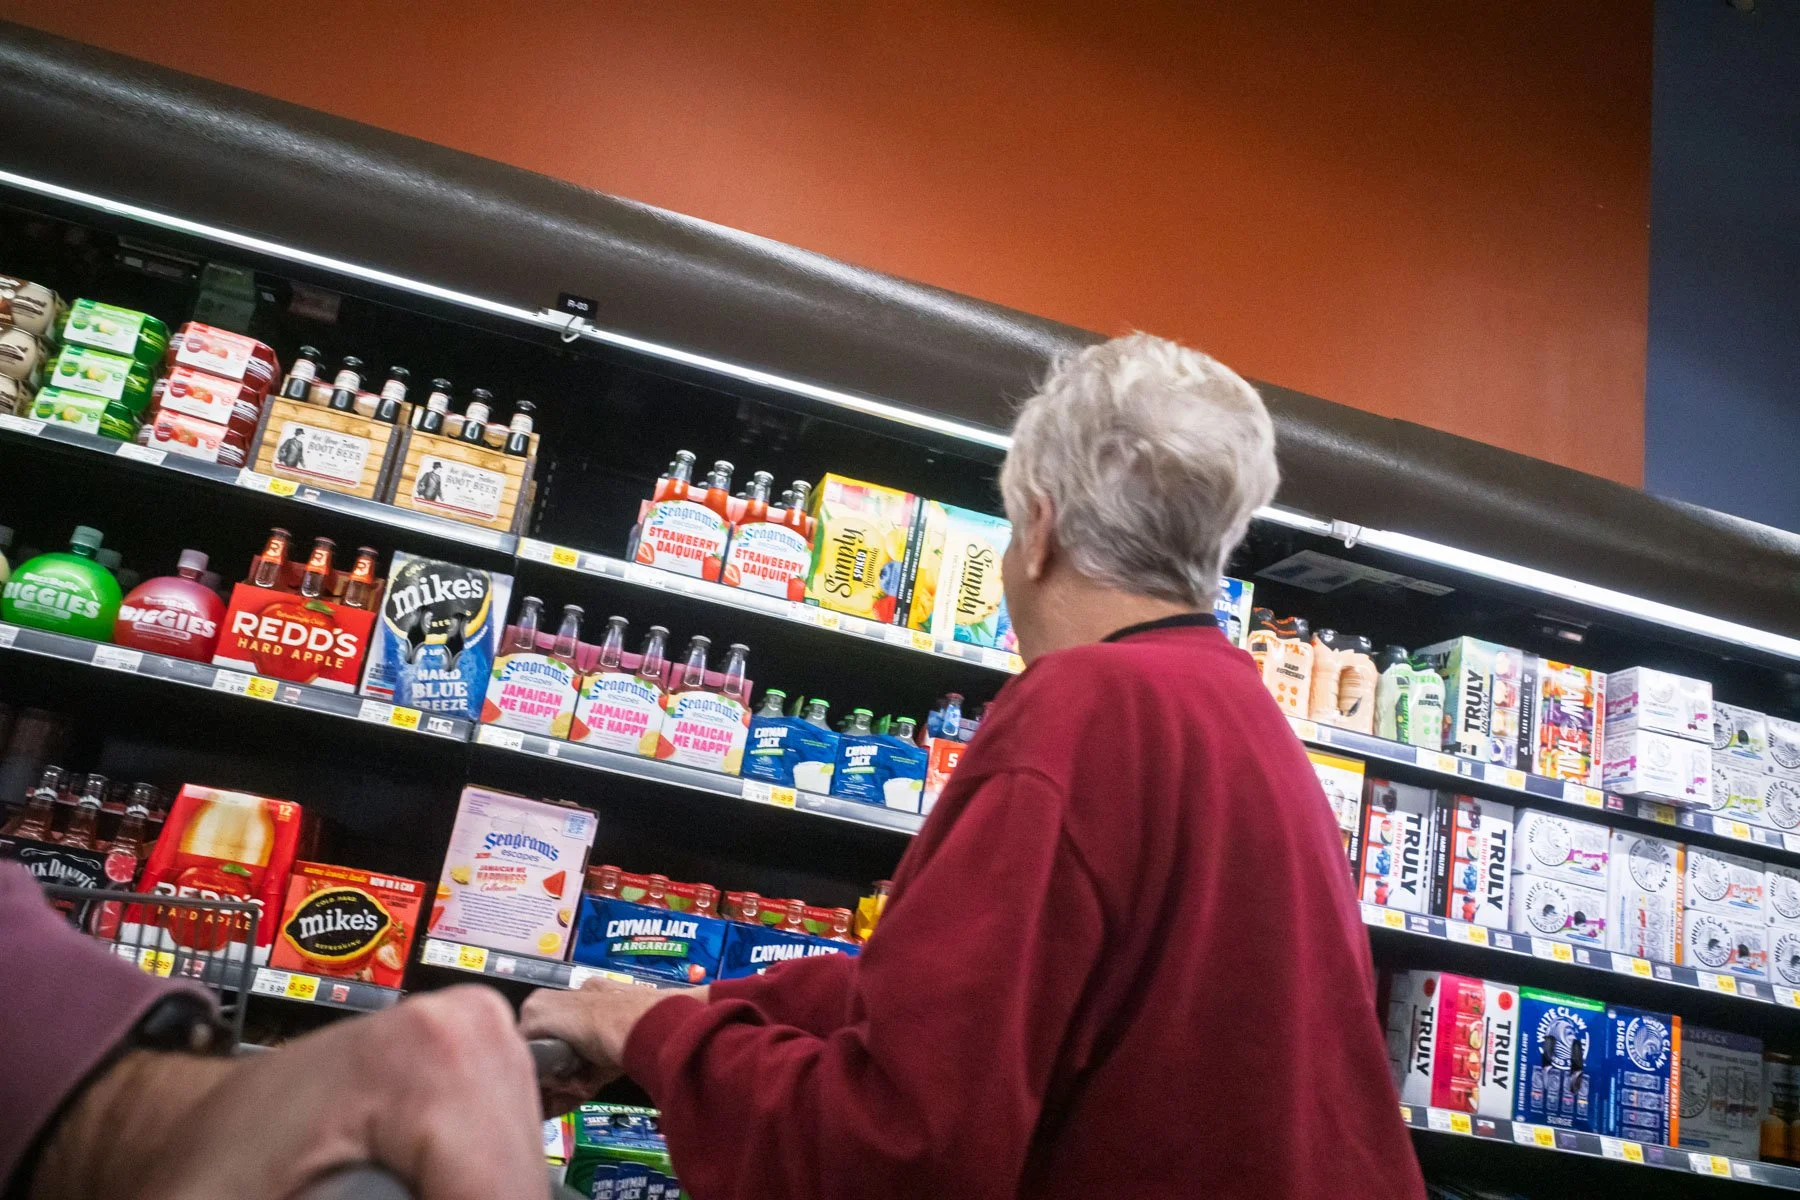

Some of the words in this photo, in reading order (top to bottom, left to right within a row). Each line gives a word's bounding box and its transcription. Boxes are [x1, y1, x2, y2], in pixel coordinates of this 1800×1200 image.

[648, 526, 720, 552] STRAWBERRY
[656, 540, 707, 561] DAIQUIRI
[735, 548, 804, 574] STRAWBERRY
[742, 562, 792, 583] DAIQUIRI
[824, 528, 866, 598] Simply
[853, 550, 867, 579] SPIKED
[957, 542, 994, 616] Simply
[391, 572, 485, 622] mike's
[118, 605, 217, 639] BIGGIES
[231, 610, 359, 658] REDD'S
[237, 637, 284, 656] HARD
[290, 649, 345, 669] APPLE
[417, 668, 462, 681] HARD
[411, 681, 469, 698] BLUE
[502, 683, 563, 706] JAMAICAN
[1463, 669, 1484, 733] TRULY
[412, 698, 469, 712] FREEZE
[499, 696, 517, 712] ME
[519, 701, 560, 721] HAPPY
[590, 702, 649, 725] JAMAICAN
[587, 715, 605, 730] ME
[606, 720, 646, 739] HAPPY
[675, 721, 733, 743] JAMAICAN
[673, 734, 690, 748] ME
[692, 738, 731, 757] HAPPY
[1765, 782, 1779, 808] WHITE
[278, 804, 293, 818] 12
[1439, 835, 1447, 851] HARD
[1528, 817, 1545, 843] WHITE
[483, 832, 560, 862] Seagram's
[501, 848, 540, 863] escapes
[1400, 812, 1423, 896] TRULY
[1437, 851, 1446, 877] SELTZER
[1486, 828, 1507, 911] TRULY
[1525, 882, 1542, 911] WHITE
[1543, 880, 1568, 901] CLAW
[156, 903, 200, 922] HAD
[298, 908, 379, 939] mike's
[606, 918, 664, 938] CAYMAN
[661, 919, 700, 940] JACK
[1691, 917, 1706, 945] WHITE
[1706, 915, 1730, 935] CLAW
[611, 941, 683, 953] MARGARITA
[750, 944, 804, 963] CAYMAN
[1774, 934, 1788, 963] WHITE
[1536, 1007, 1557, 1043] WHITE
[1557, 1006, 1588, 1031] CLAW
[1415, 1006, 1435, 1077] TRULY
[1616, 1019, 1626, 1057] SURGE
[1641, 1015, 1669, 1038] WHITE
[1655, 1038, 1671, 1069] CLAW
[1492, 1020, 1512, 1090] TRULY
[1671, 1050, 1680, 1086] VARIETY
[1546, 1115, 1573, 1128] SURGE
